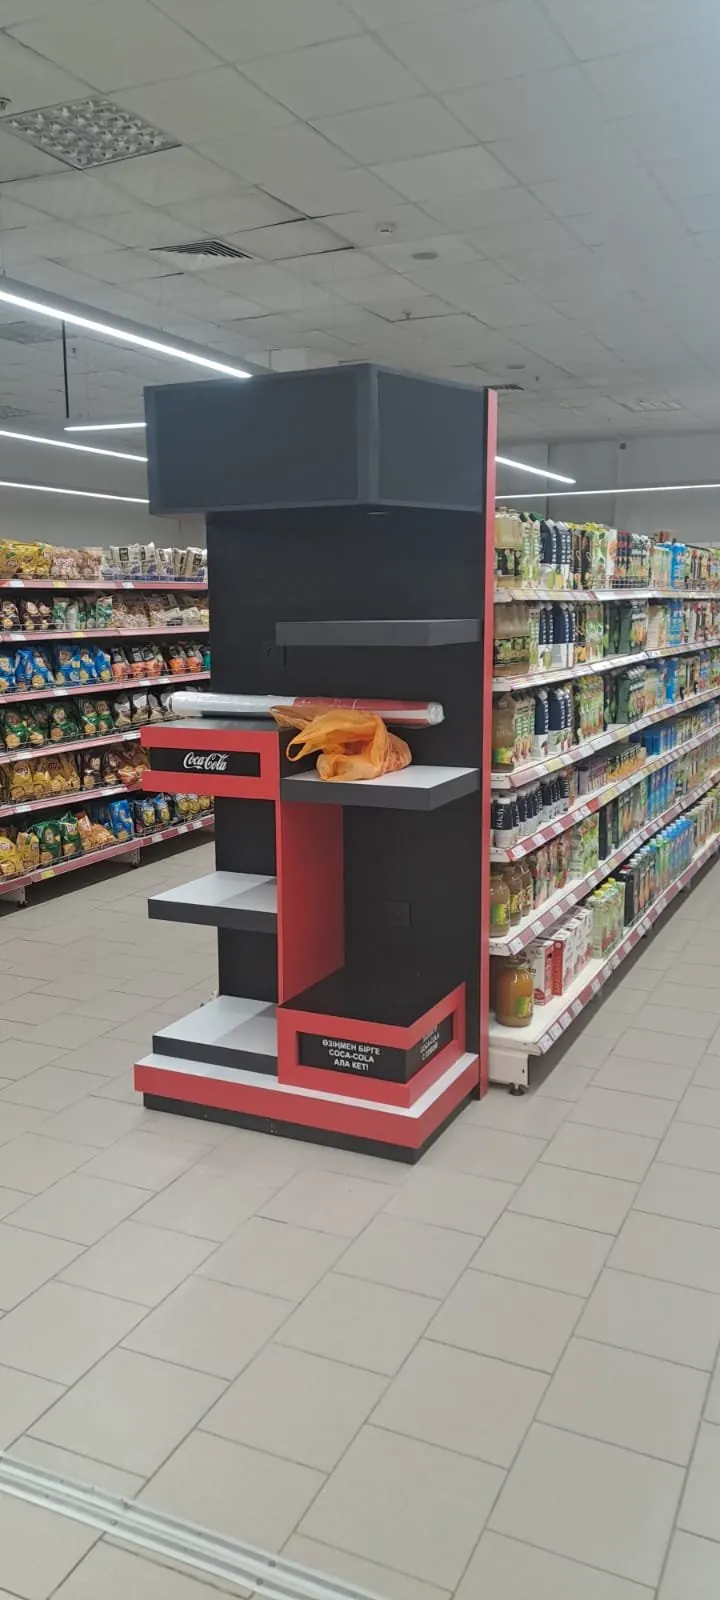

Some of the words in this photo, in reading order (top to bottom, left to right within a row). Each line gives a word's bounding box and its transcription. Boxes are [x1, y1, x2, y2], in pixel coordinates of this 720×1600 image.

[183, 752, 230, 771] Coca-Cola
[322, 1039, 357, 1051] ӨЗІҢМЕН
[358, 1044, 381, 1056] БІРГЕ
[328, 1049, 375, 1063] COCA-COLA
[334, 1058, 351, 1068] АЛА
[352, 1061, 369, 1071] КЕТ!
